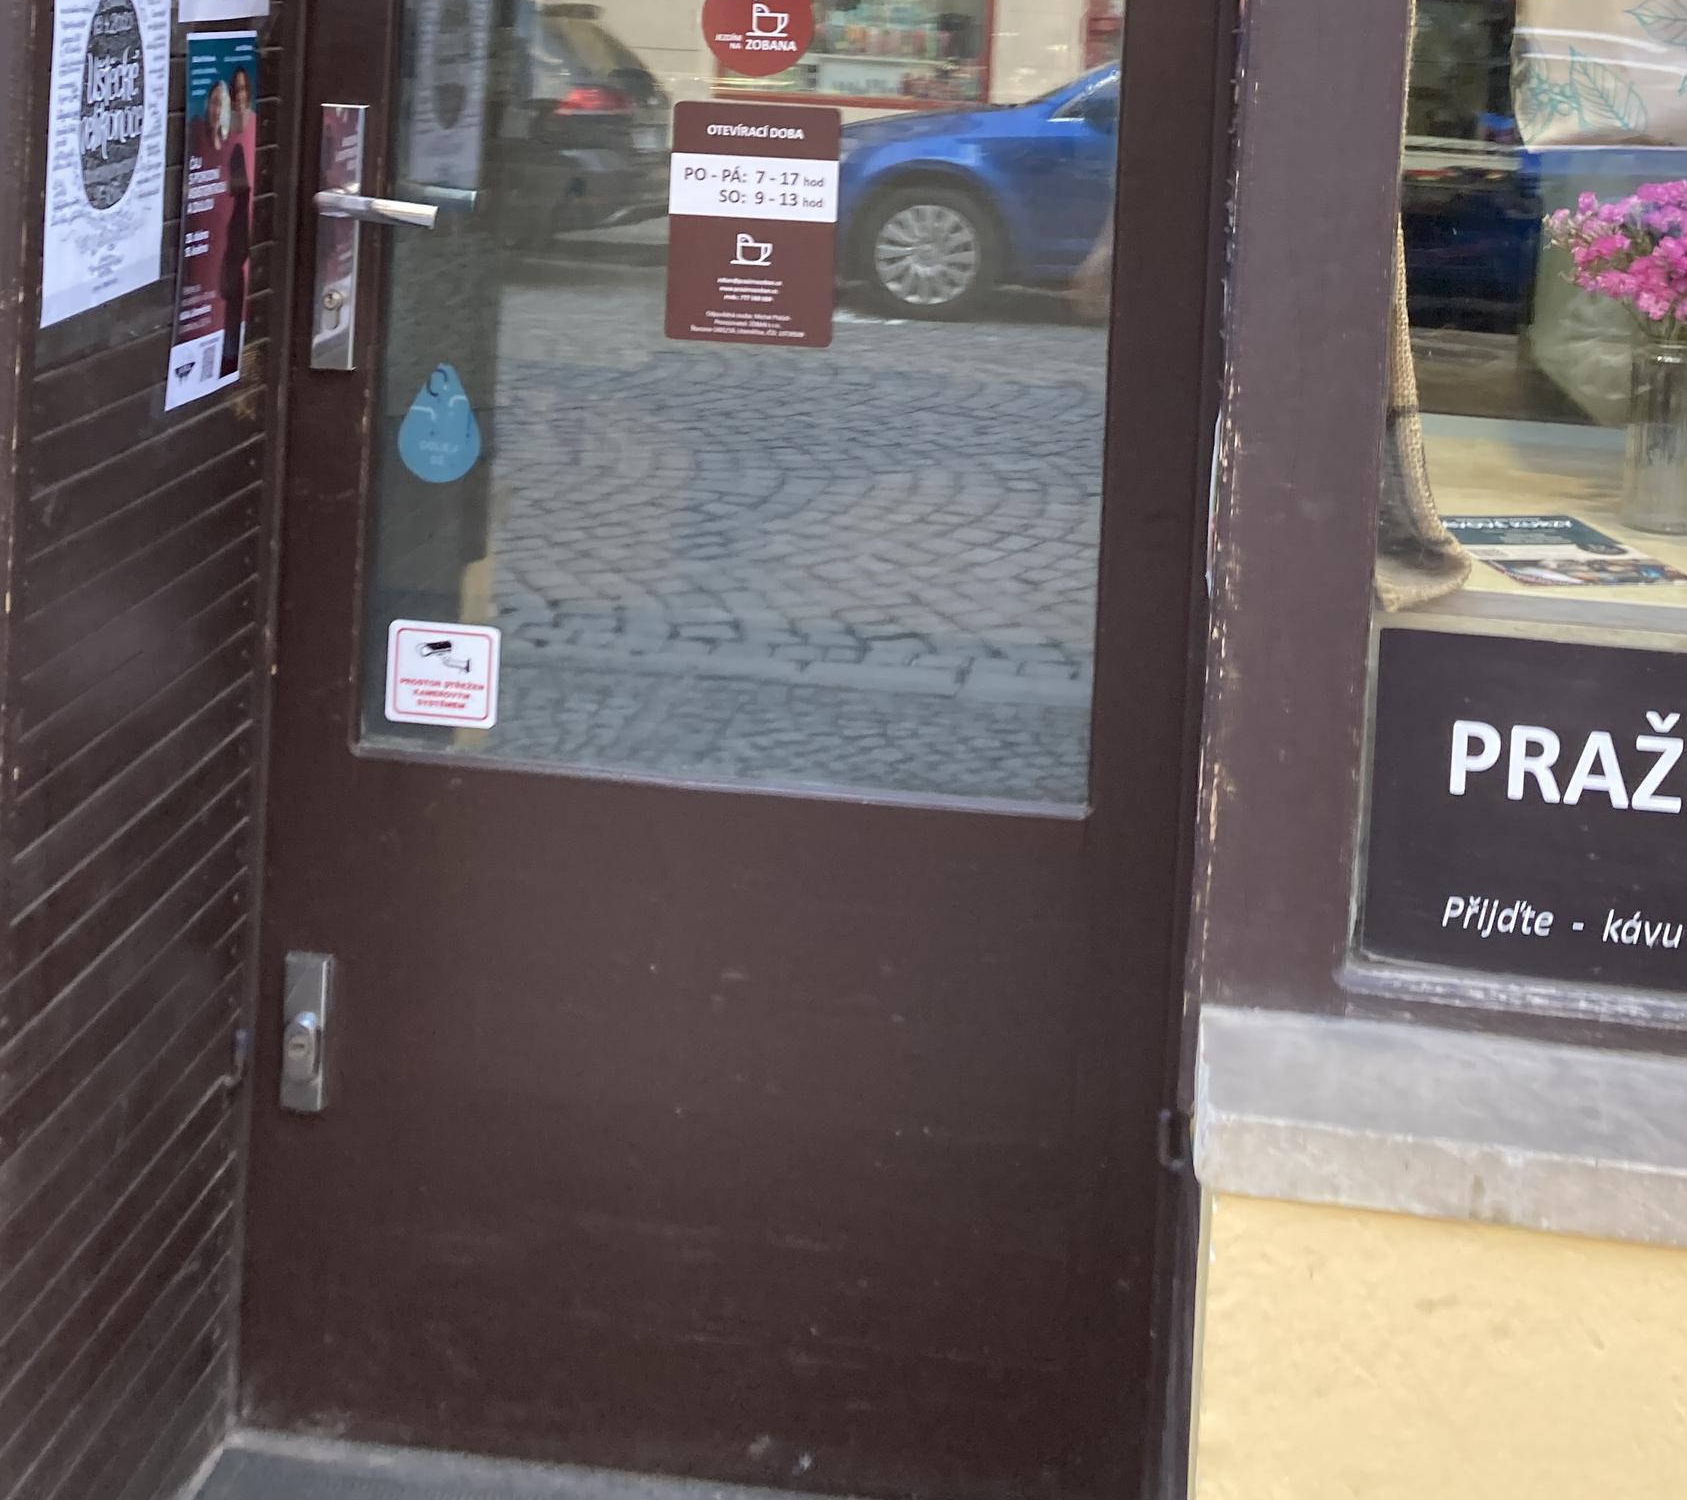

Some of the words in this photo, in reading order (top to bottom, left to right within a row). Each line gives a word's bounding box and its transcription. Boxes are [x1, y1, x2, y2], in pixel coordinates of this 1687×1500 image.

[745, 39, 798, 52] ZOBANA
[707, 123, 769, 138] OTEVÍRACÍ
[769, 127, 805, 140] DOBA
[684, 166, 707, 181] PO
[721, 165, 747, 183] PÁ:
[755, 170, 766, 184] 7
[781, 172, 800, 186] 17
[803, 177, 825, 188] hod
[718, 189, 747, 204] SO:
[754, 191, 765, 205] 9
[779, 192, 799, 206] 13
[802, 197, 824, 208] hod
[1448, 710, 1685, 816] PRAŽ
[1441, 895, 1555, 939] Přijďte
[1602, 908, 1684, 950] kávu
